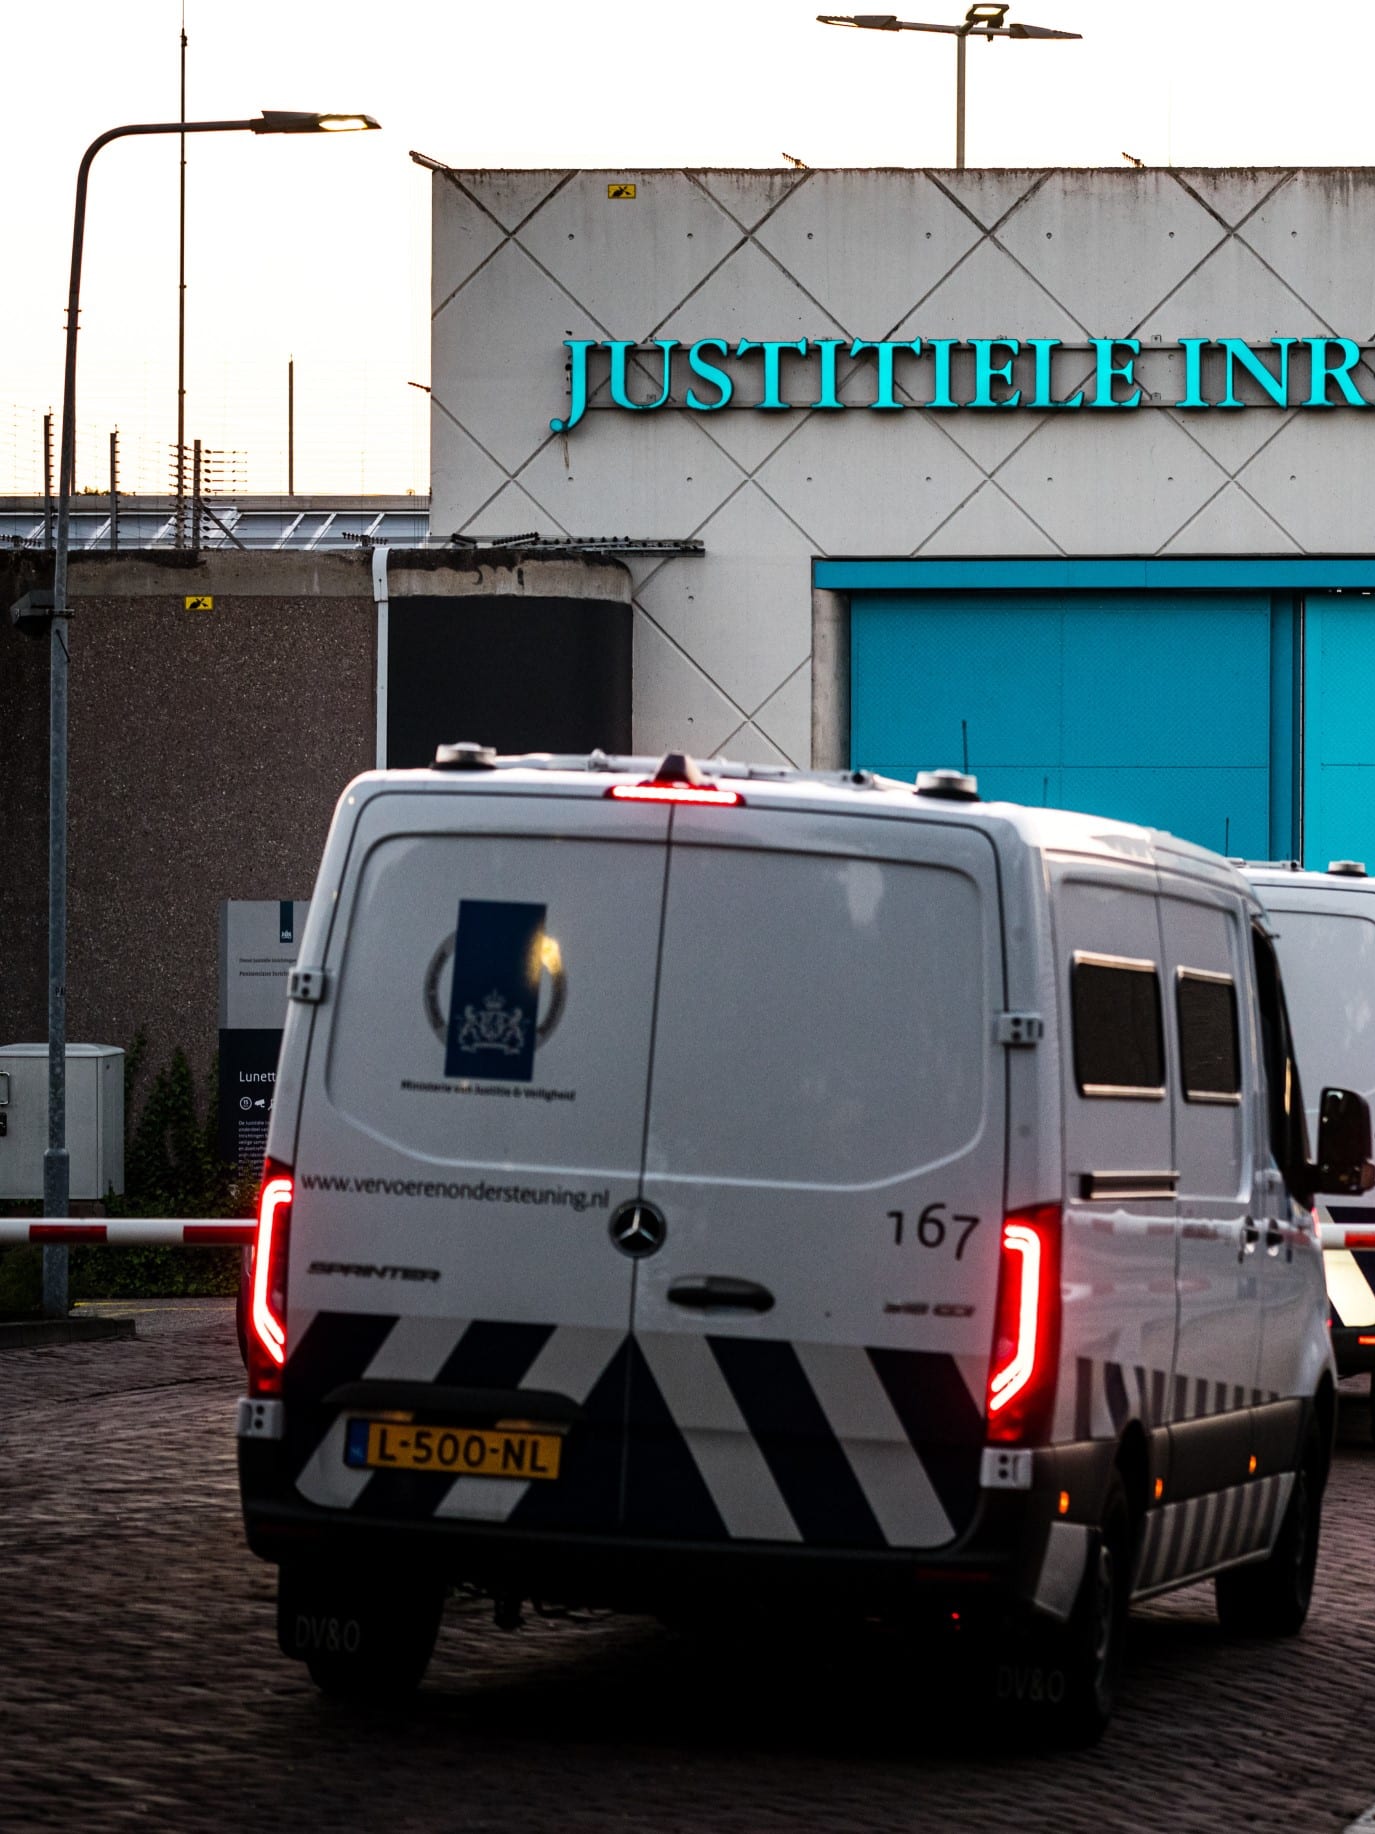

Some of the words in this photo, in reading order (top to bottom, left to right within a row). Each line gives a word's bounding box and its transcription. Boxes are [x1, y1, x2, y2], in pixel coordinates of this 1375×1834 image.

[550, 337, 1143, 433] JUSTITIELE
[239, 1071, 276, 1083] Lunett
[301, 1173, 610, 1213] www.vervoerenondersteuning.nl
[886, 1202, 981, 1262] 167
[377, 1428, 548, 1473] L-500-NL
